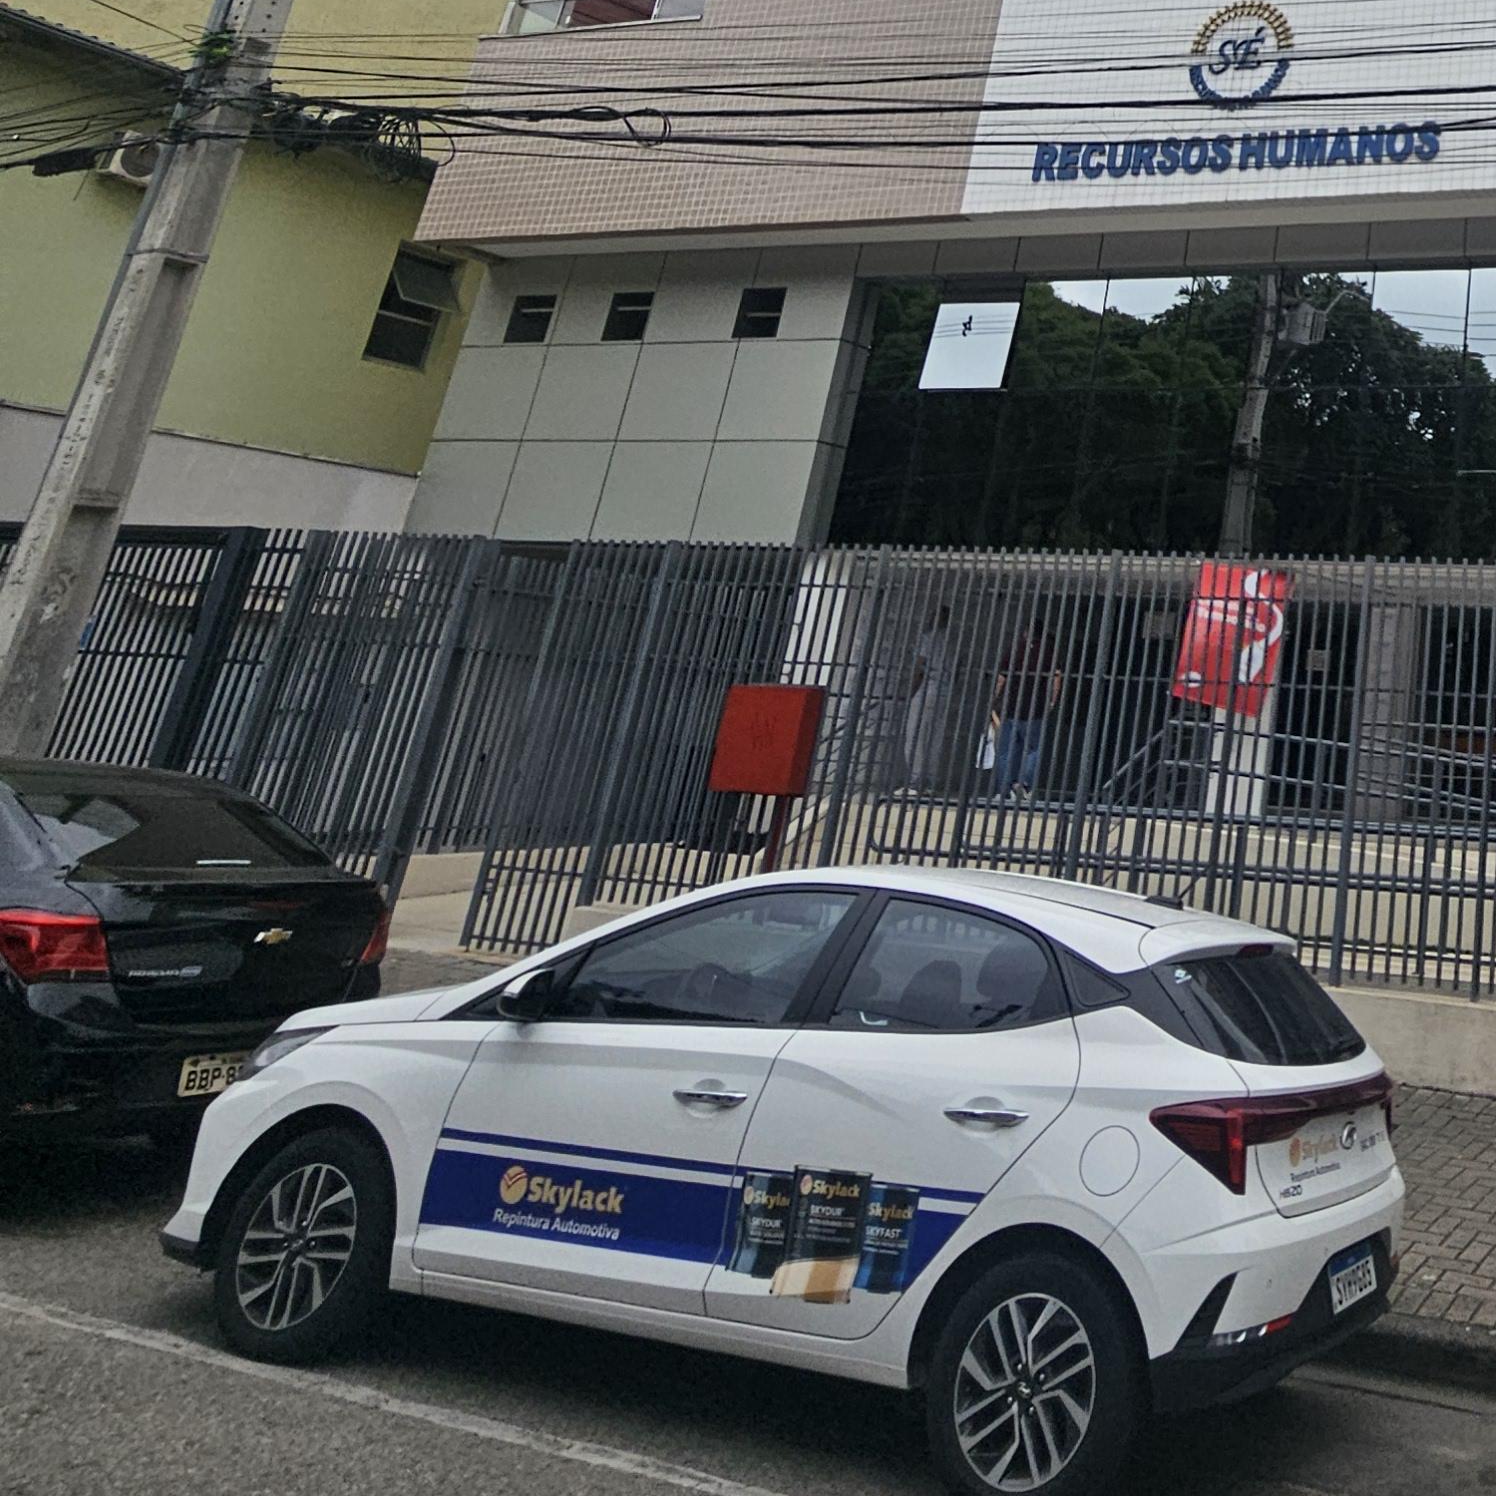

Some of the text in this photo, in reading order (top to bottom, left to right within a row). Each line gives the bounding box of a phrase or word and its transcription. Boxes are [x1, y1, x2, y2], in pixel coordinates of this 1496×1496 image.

[1031, 121, 1441, 182] RECURSOS HUMANOS
[527, 1176, 624, 1214] Skylack
[813, 1179, 860, 1199] Skylack
[868, 1201, 913, 1221] Skylack
[492, 1208, 620, 1241] Repintura Automotiva
[865, 1225, 901, 1239] SKYFAST
